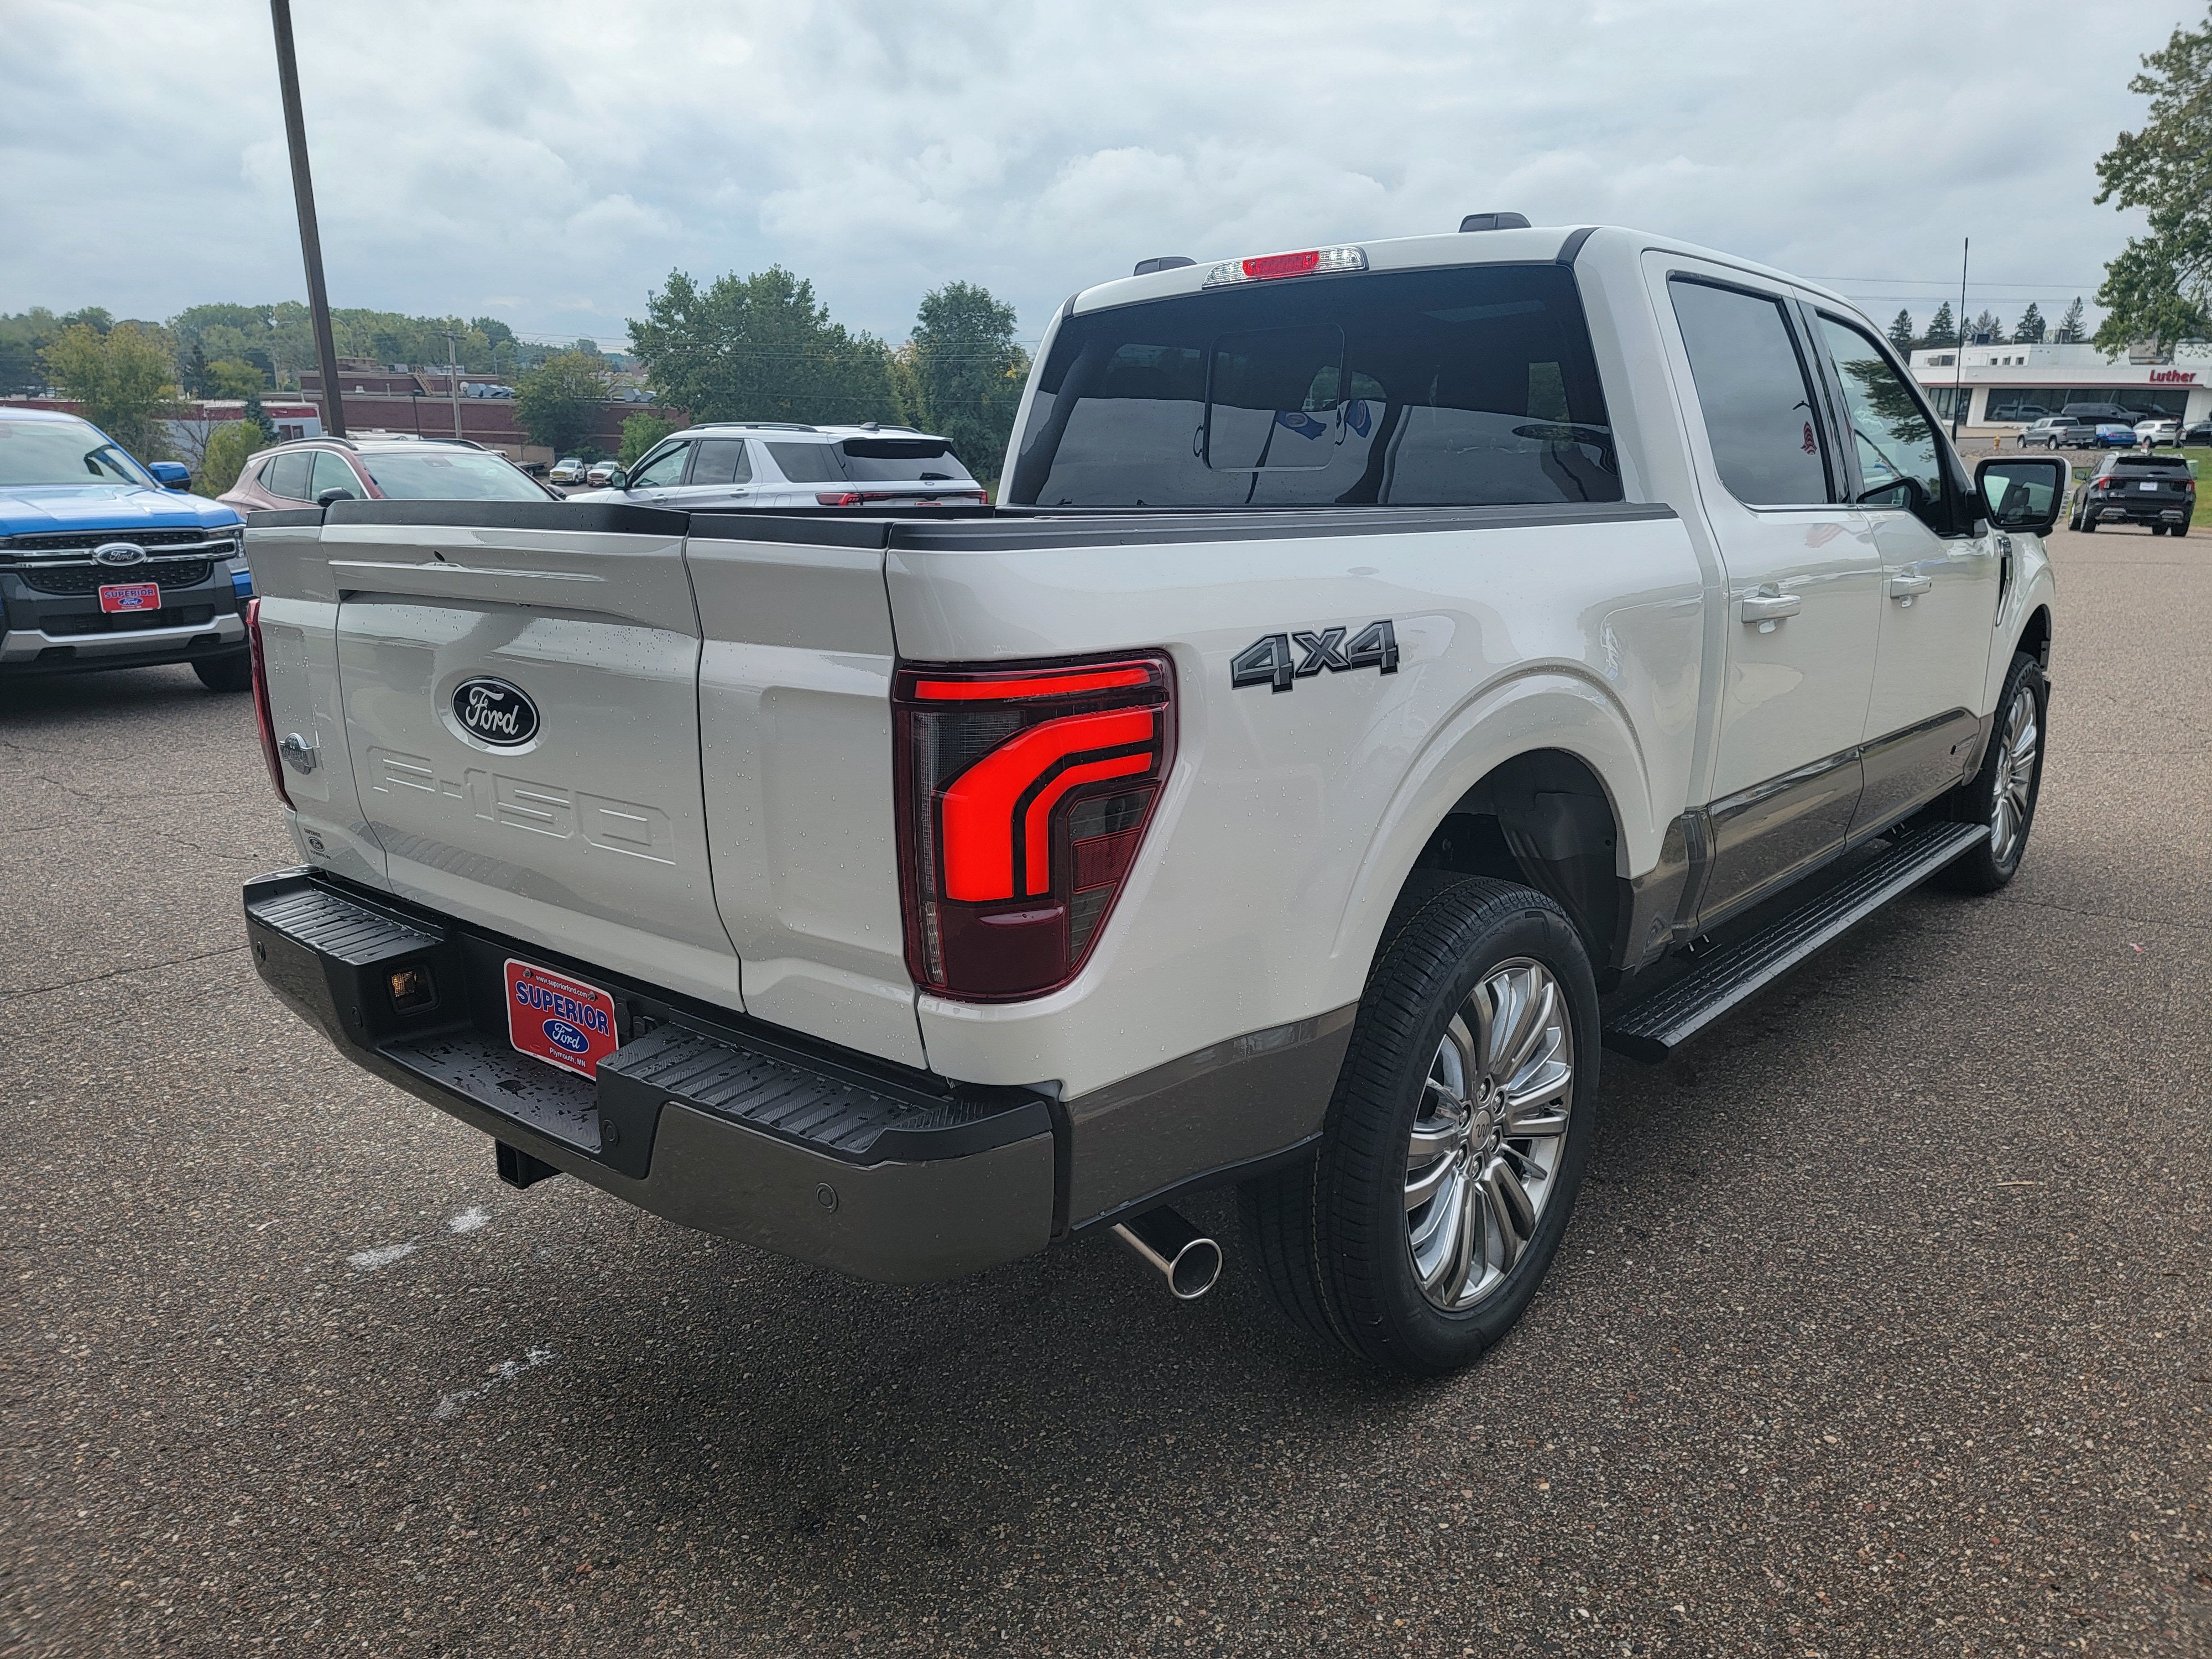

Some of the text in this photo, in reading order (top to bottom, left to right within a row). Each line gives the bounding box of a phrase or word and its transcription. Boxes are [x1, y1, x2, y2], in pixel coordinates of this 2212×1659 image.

[2150, 369, 2197, 382] Luther
[109, 550, 134, 561] Ford
[105, 588, 155, 599] SUPERIOR
[466, 687, 519, 735] Ford
[366, 745, 676, 865] F-150
[535, 975, 588, 999] www.superiorford.com
[515, 980, 610, 1037] SUPERIOR
[552, 1022, 580, 1049] Ford
[549, 1047, 586, 1068] Plymouth, MN
